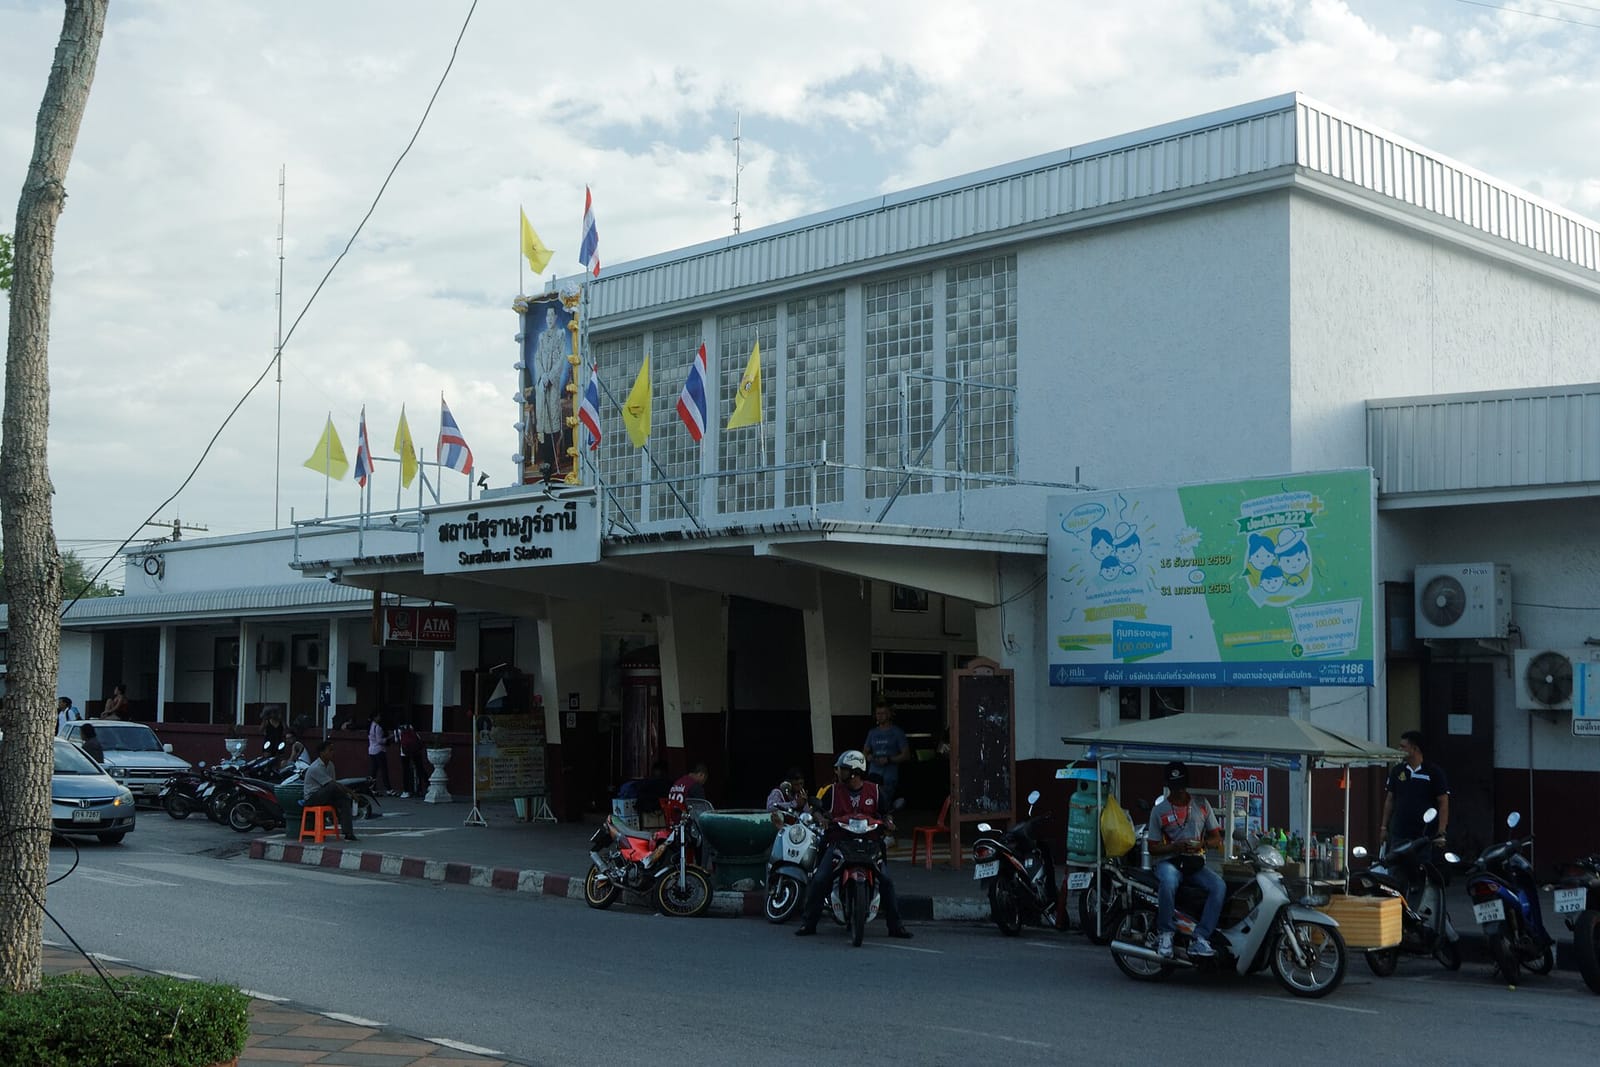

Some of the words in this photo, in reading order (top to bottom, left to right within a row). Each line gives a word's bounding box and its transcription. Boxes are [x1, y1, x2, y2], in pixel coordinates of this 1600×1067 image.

[438, 501, 577, 547] สถานีสุราษฎร์ธานี
[458, 549, 510, 566] Suratthani
[514, 545, 553, 560] Station
[1174, 585, 1206, 596] มกราคม
[424, 618, 450, 630] ATM
[1341, 664, 1364, 674] 1186
